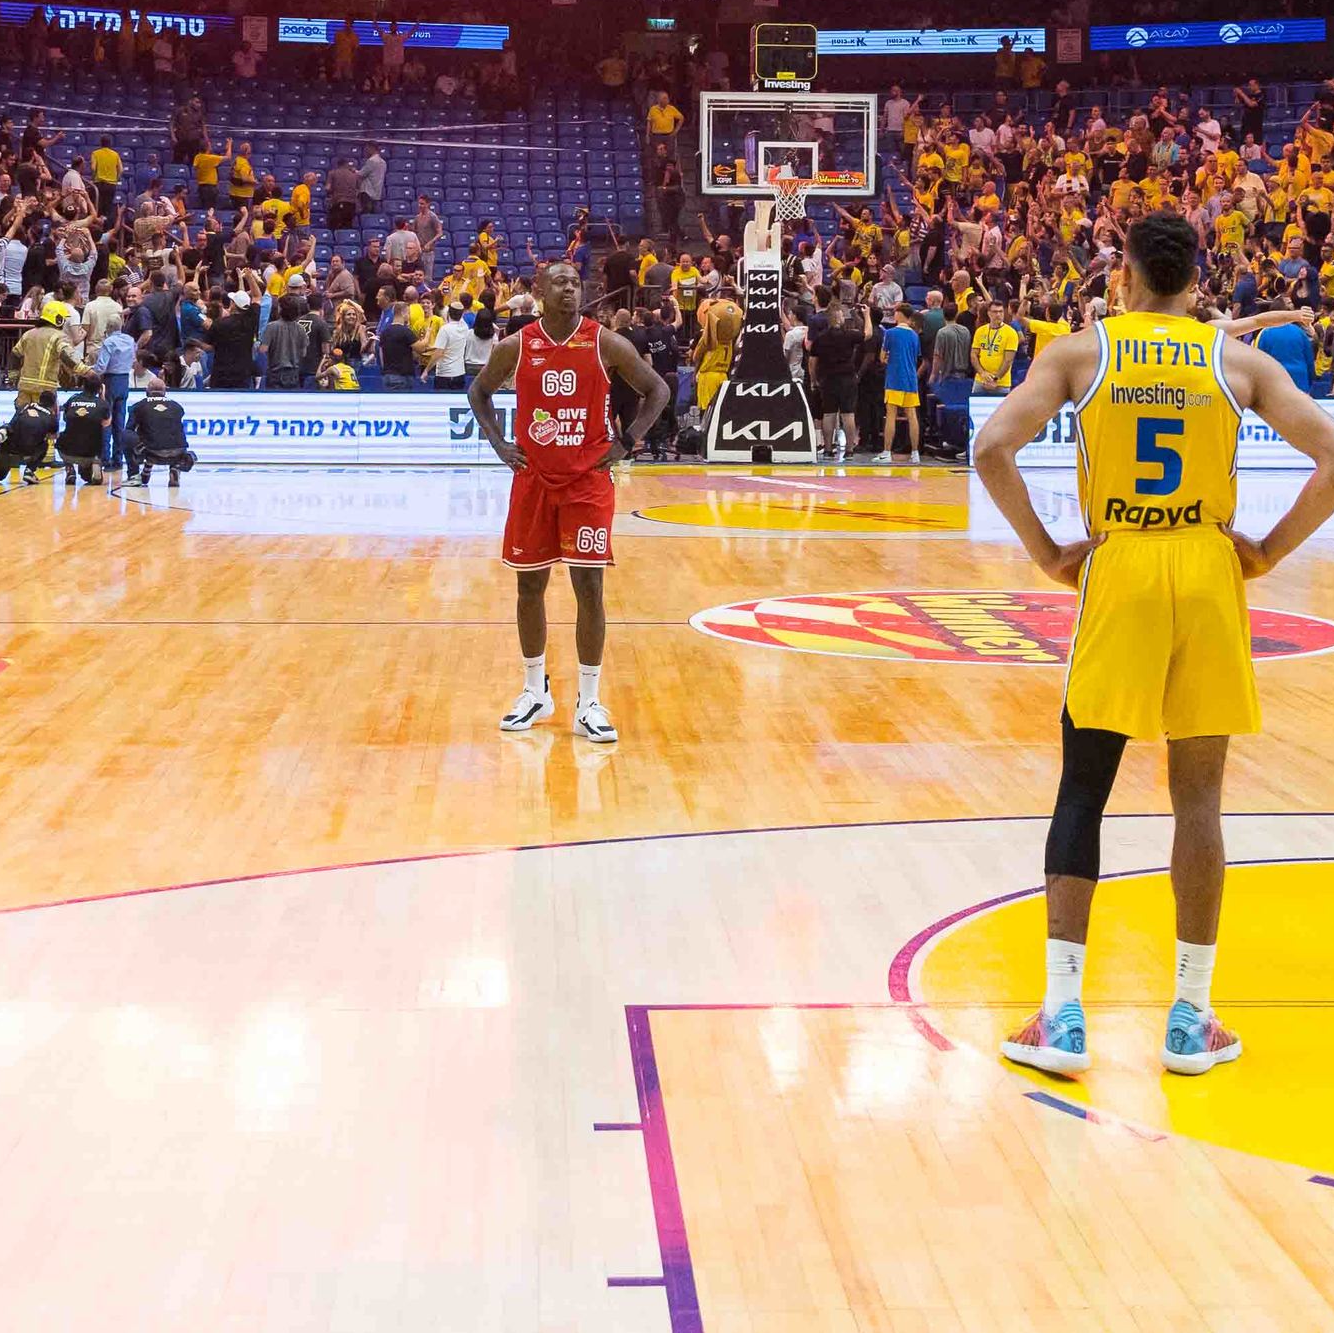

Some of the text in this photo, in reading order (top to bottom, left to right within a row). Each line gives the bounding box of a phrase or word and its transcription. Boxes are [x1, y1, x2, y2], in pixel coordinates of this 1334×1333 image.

[59, 9, 123, 32] מדיה
[764, 79, 811, 91] Investing
[1116, 337, 1207, 372] בולדווין
[542, 369, 577, 397] 69
[736, 383, 790, 397] KIA
[1111, 382, 1212, 410] Investing.com
[557, 408, 587, 420] GIVE
[183, 415, 410, 438] אשראי מהיר ליזמים
[560, 421, 585, 433] IT A
[722, 420, 803, 441] KIA
[1135, 417, 1184, 495] 5
[576, 526, 608, 554] 69
